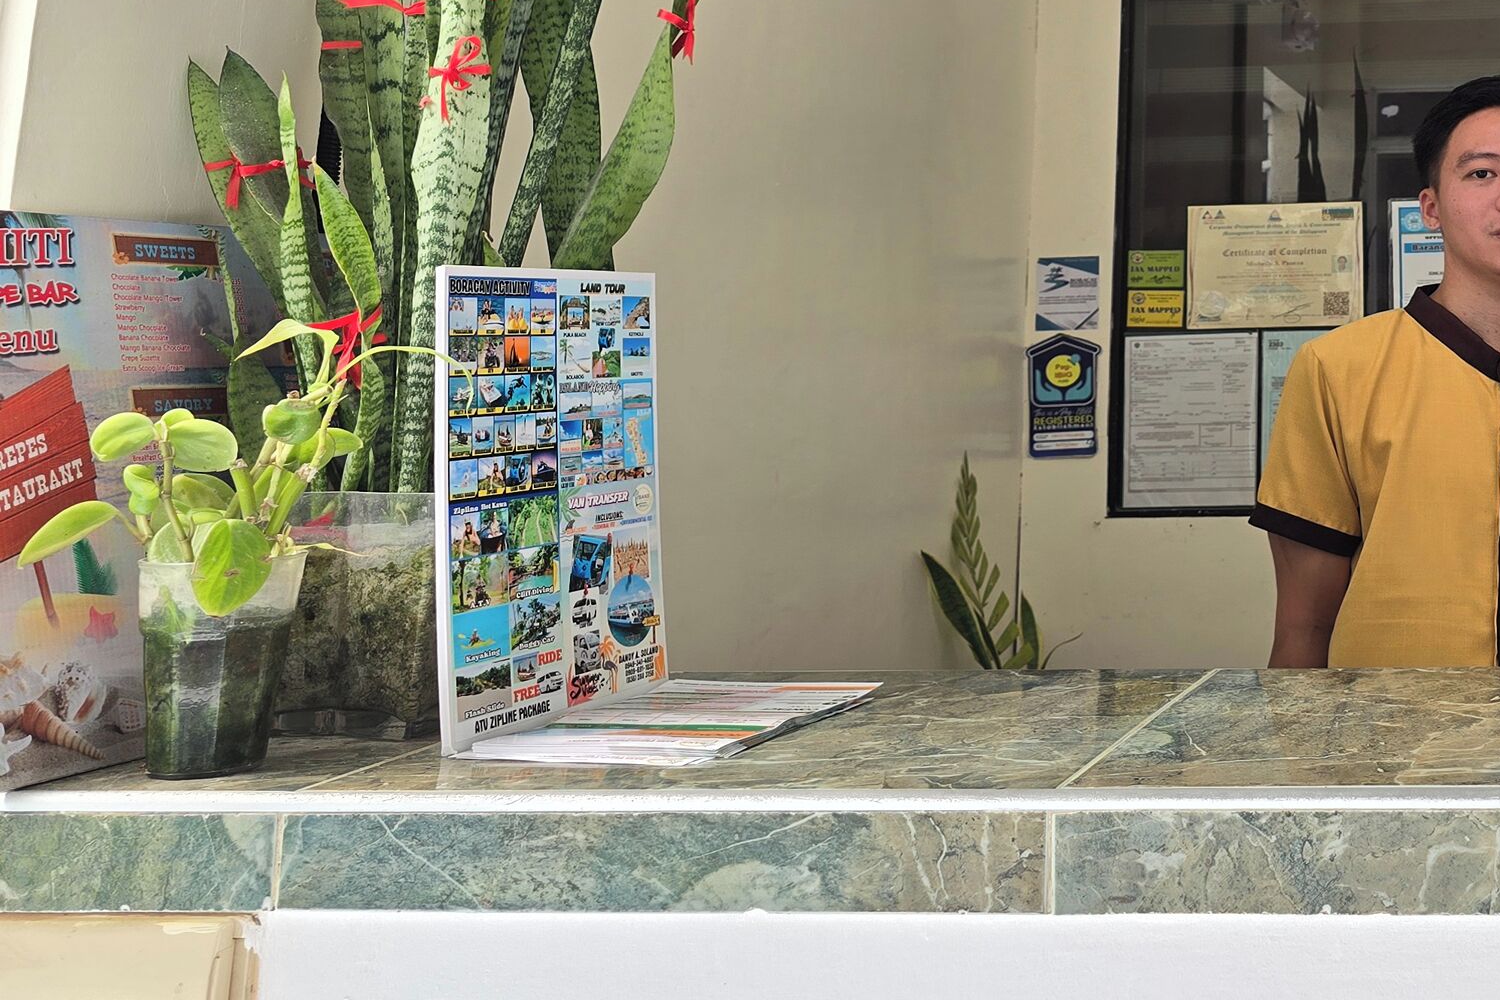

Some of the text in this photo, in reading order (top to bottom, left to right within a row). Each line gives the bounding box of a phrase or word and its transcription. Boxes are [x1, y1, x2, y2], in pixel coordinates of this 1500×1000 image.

[135, 244, 196, 260] SWEETS
[1279, 247, 1328, 257] Completion
[1147, 265, 1180, 273] MAPPED
[111, 273, 139, 281] Chocolate
[27, 281, 78, 303] BAR
[112, 283, 140, 291] Chocolate
[450, 279, 491, 294] BORACAY
[492, 280, 531, 296] ACTIVITY
[580, 283, 626, 294] LAND TOUR
[143, 295, 163, 303] Mango
[114, 303, 145, 312] Strawberry
[1148, 306, 1181, 314] MAPPED
[117, 324, 138, 332] Mango
[120, 344, 140, 352] Mango
[163, 344, 191, 352] Chocolate
[121, 354, 138, 362] Crepe
[123, 364, 137, 372] Extra
[138, 364, 156, 373] Scoop
[166, 364, 184, 372] Cream
[154, 398, 213, 412] SAVORY
[1034, 415, 1094, 425] REGISTERED
[0, 458, 83, 512] TAURANT
[568, 491, 629, 509] VAN TRANSFER
[453, 505, 479, 515] Zipline
[532, 585, 554, 596] Diving
[519, 636, 555, 651] Buggy Car
[465, 648, 501, 663] Kayaking
[537, 649, 563, 666] RIDE
[514, 683, 540, 703] FREE
[465, 701, 505, 720] Flash Slide
[475, 700, 551, 734] ATV ZIPLINE PACKAGE
